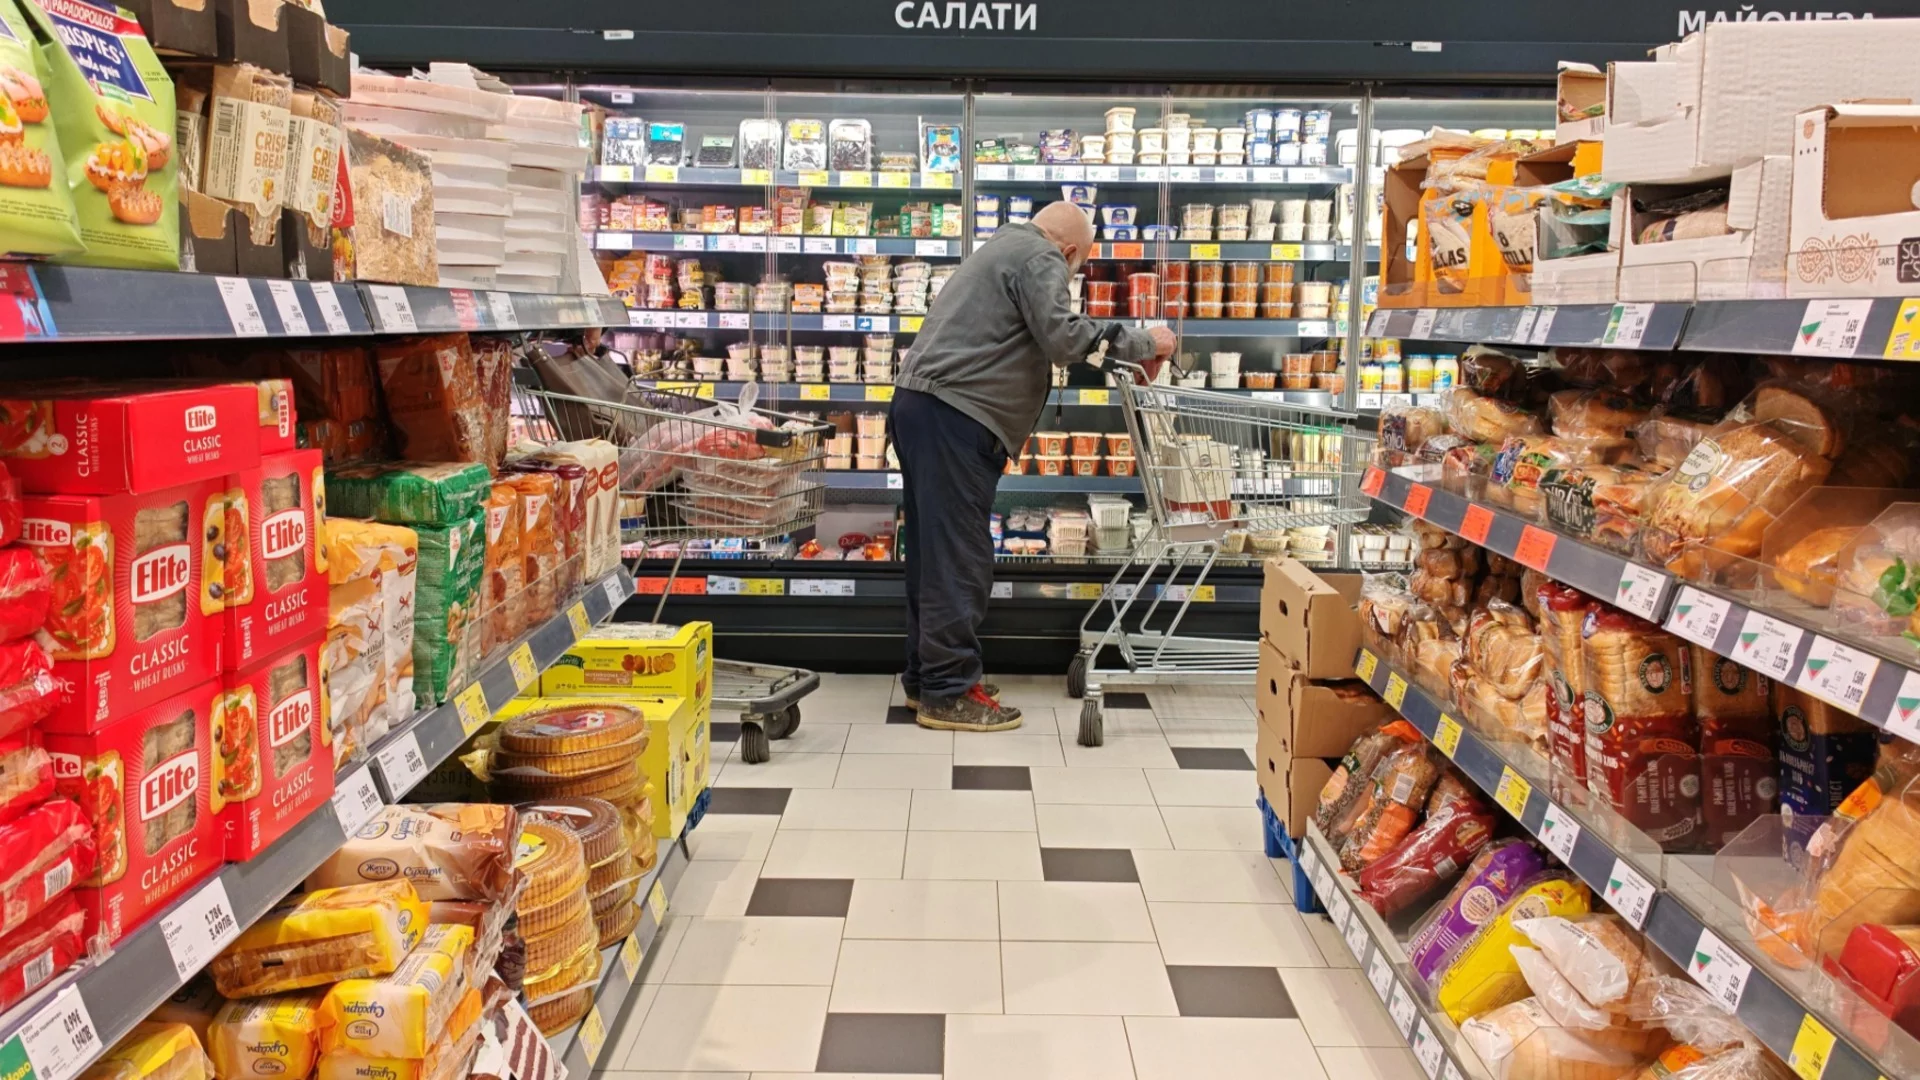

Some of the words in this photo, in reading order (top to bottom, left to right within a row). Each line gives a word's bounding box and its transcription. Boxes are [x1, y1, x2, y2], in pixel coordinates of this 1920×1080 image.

[51, 0, 115, 31] PAPADOPOULOS
[894, 1, 1037, 31] САЛАТИ
[255, 131, 287, 152] CRISP
[253, 151, 285, 170] BREAD
[187, 409, 215, 428] Elite
[76, 413, 90, 477] CLASSIC
[183, 434, 222, 453] CLASSIC
[264, 515, 305, 553] Elite
[135, 549, 188, 596] Elite
[265, 588, 308, 621] CLASSIC
[268, 618, 287, 636] WHEAT
[130, 634, 189, 675] CLASSIC
[133, 670, 161, 692] WHEAT
[162, 659, 186, 681] RUSKS
[272, 700, 311, 742] Elite
[144, 762, 196, 816] Elite
[272, 765, 314, 808] CLASSIC
[141, 837, 198, 890] CLASSIC
[403, 866, 442, 878] Сухари
[144, 880, 169, 906] WHEAT
[204, 903, 223, 925] 1.78€
[343, 1001, 385, 1018] Сухари
[247, 1040, 289, 1057] Сухари
